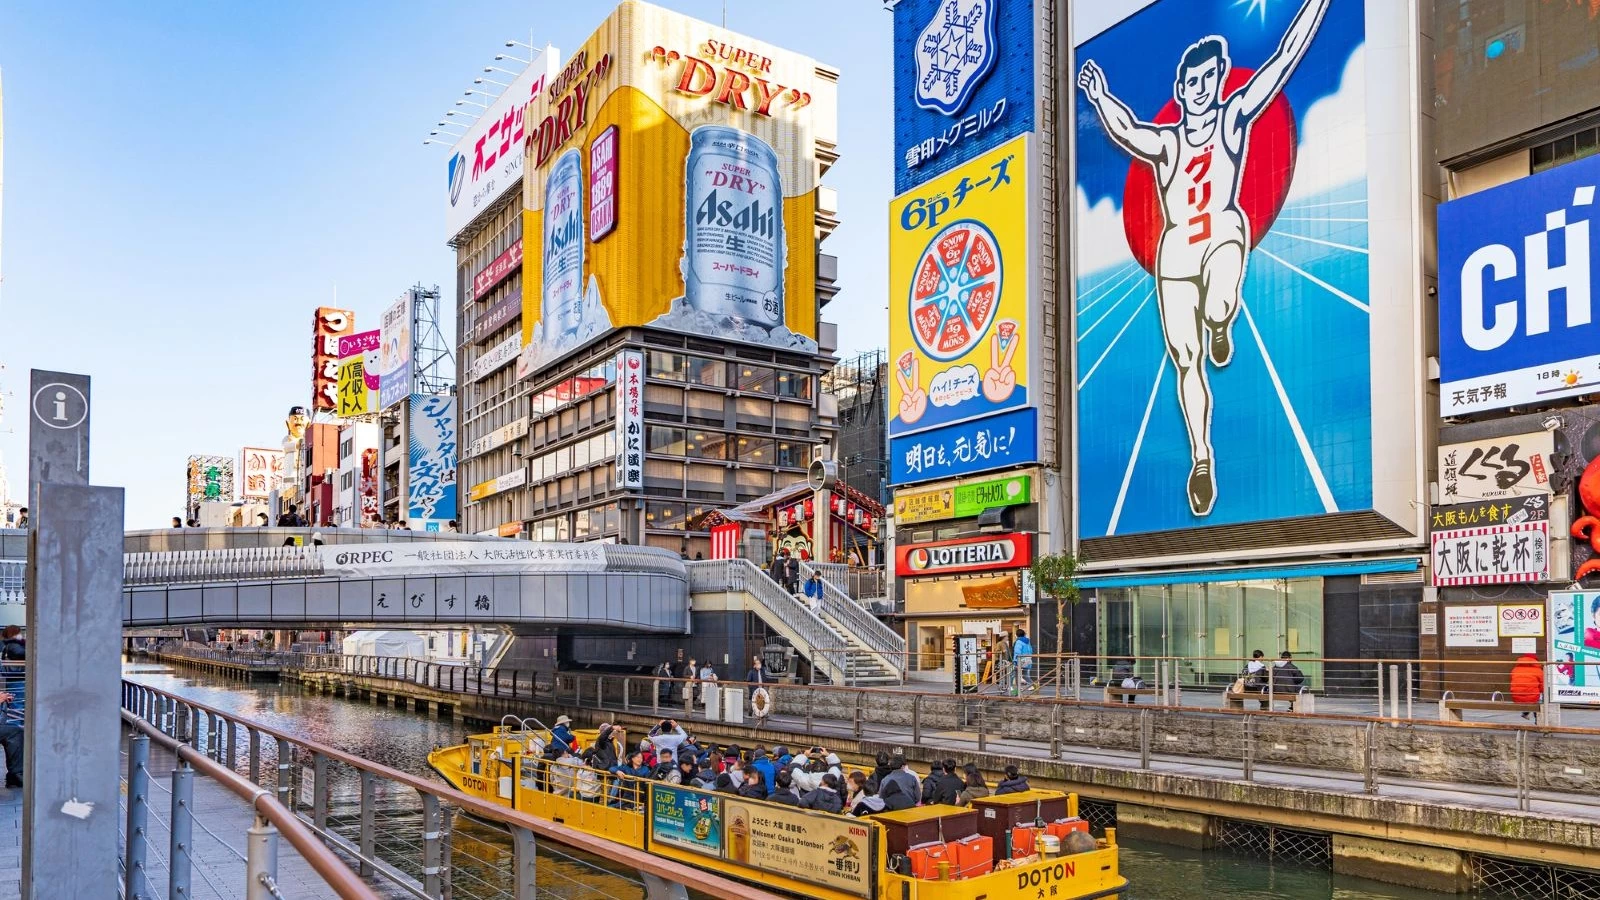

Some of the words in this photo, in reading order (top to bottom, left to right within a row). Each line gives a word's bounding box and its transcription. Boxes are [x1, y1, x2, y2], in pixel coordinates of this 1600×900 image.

[705, 39, 772, 73] SUPER
[549, 51, 586, 104] SUPER
[905, 97, 1006, 169] 雪印メグミルク
[721, 162, 751, 176] SUPER
[952, 155, 1015, 209] チーズ
[591, 170, 613, 208] 1889
[1185, 144, 1215, 245] グリコ
[591, 200, 612, 238] OSAKA
[695, 188, 774, 240] Asahi
[546, 207, 580, 265] Asahi
[726, 235, 746, 253] 生
[942, 232, 965, 249] SNOW
[976, 240, 993, 268] SNOW
[712, 262, 760, 279] スーパードライ
[917, 260, 932, 293] SNOW
[977, 290, 992, 322] SNOW
[916, 314, 932, 339] SNOW
[942, 335, 965, 349] SNOW
[340, 365, 351, 414] バイト
[352, 362, 363, 412] 高収入
[628, 372, 639, 417] 本場の味
[1452, 383, 1507, 407] 天気予報
[422, 398, 456, 484] シャッターは
[627, 421, 641, 483] かに道楽
[1443, 449, 1458, 496] 道頓堀
[1458, 443, 1531, 490] くくる
[1432, 503, 1513, 528] 大阪もんを食す
[1529, 509, 1545, 520] 2F
[404, 549, 479, 562] 一般社団法人
[931, 543, 1004, 565] LOTTERIA
[1437, 534, 1530, 576] 大阪に乾杯
[1535, 537, 1544, 563] 検索
[377, 592, 491, 611] えびす橋
[462, 776, 487, 792] DOTON
[752, 829, 776, 840] Welcome!
[778, 834, 794, 844] Osaka
[797, 838, 824, 850] Dotonbori
[849, 826, 867, 837] KIRIN
[828, 857, 860, 874] 一番搾り
[828, 869, 841, 878] KIRIN
[1018, 861, 1075, 890] DOTON
[1037, 884, 1058, 899] 大阪
